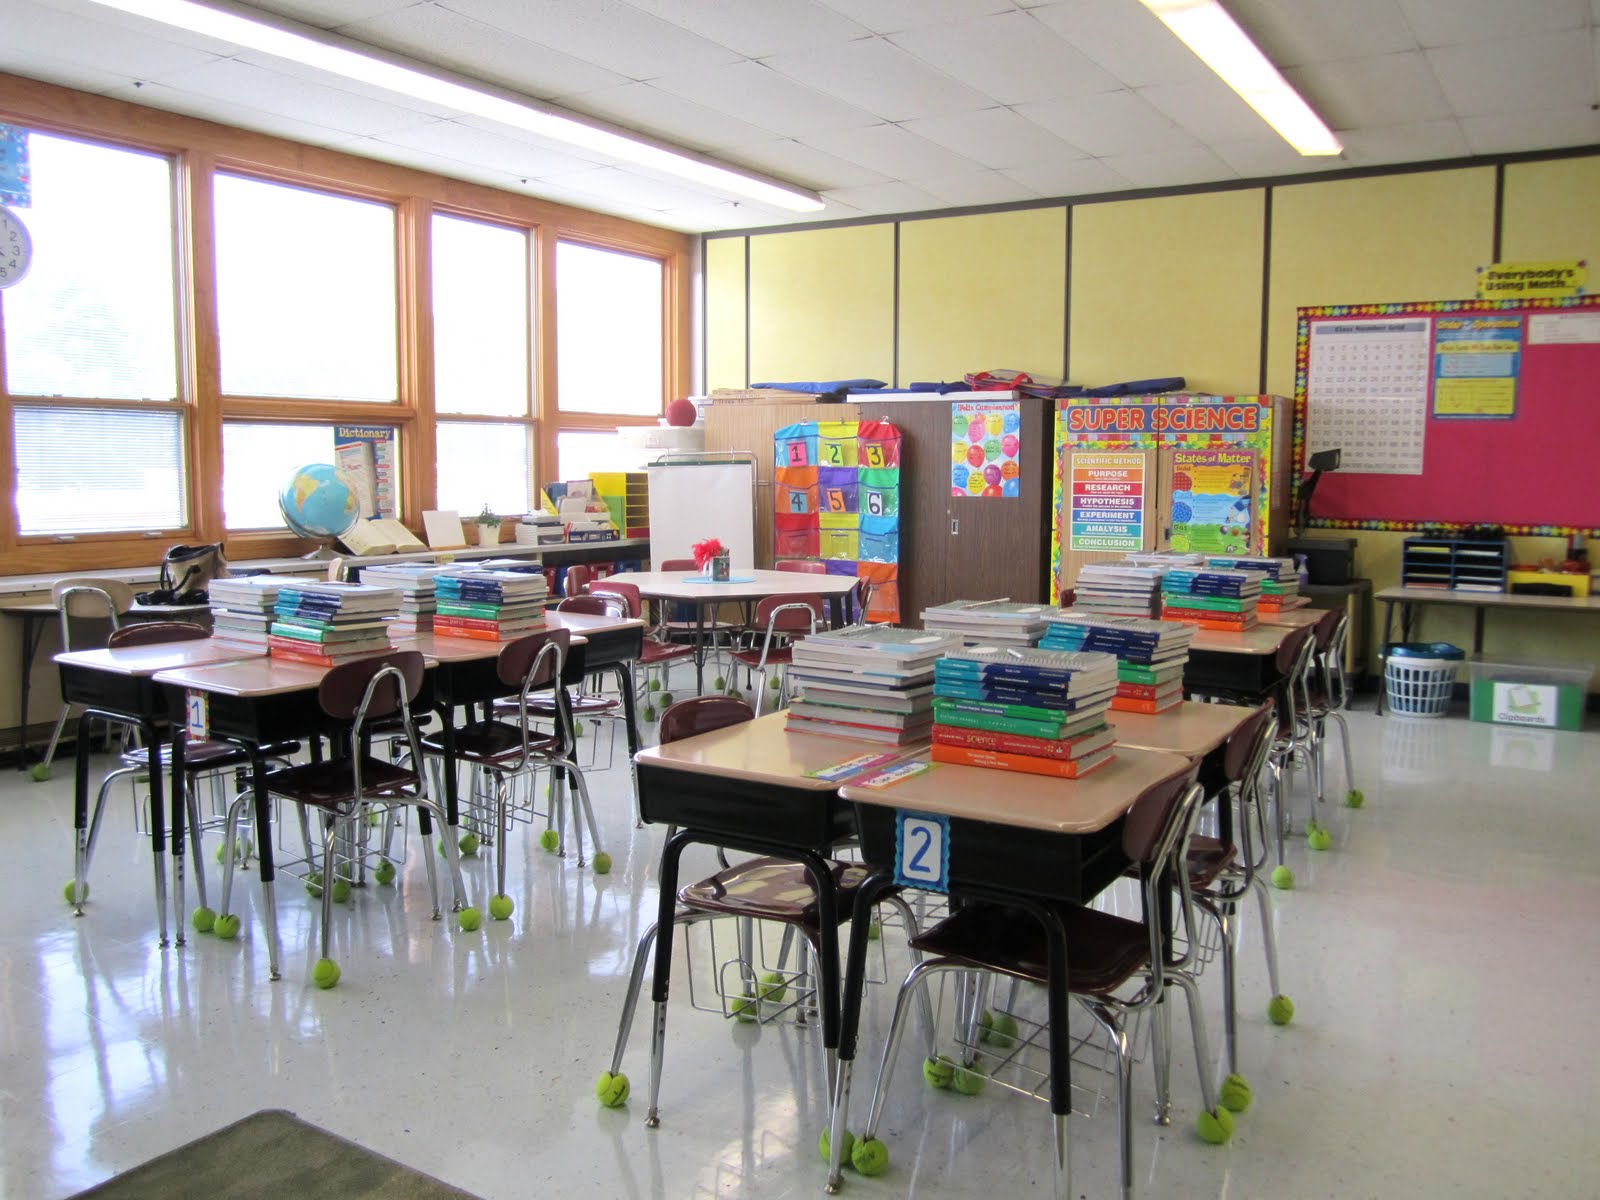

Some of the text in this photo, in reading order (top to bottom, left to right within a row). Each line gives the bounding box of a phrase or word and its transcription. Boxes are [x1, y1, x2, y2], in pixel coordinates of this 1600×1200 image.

[10, 232, 17, 241] 2
[13, 245, 20, 256] 3
[9, 259, 17, 268] 4
[1, 267, 7, 277] 5
[1069, 406, 1258, 430] SUPER SCIENCE
[339, 427, 391, 439] Dictionary
[792, 444, 882, 465] 1 2 3
[1175, 453, 1207, 463] States
[1217, 453, 1251, 463] Matter
[1077, 457, 1141, 465] SCIENTIFIC METHOD
[791, 490, 880, 515] 4 5 6
[1080, 511, 1135, 519] EXPERIMENT
[1086, 525, 1128, 533] ANALYSIS
[1078, 538, 1135, 547] CONCLUSION
[192, 700, 203, 728] 1
[1498, 712, 1545, 723] Clipboards
[909, 826, 931, 873] 2
